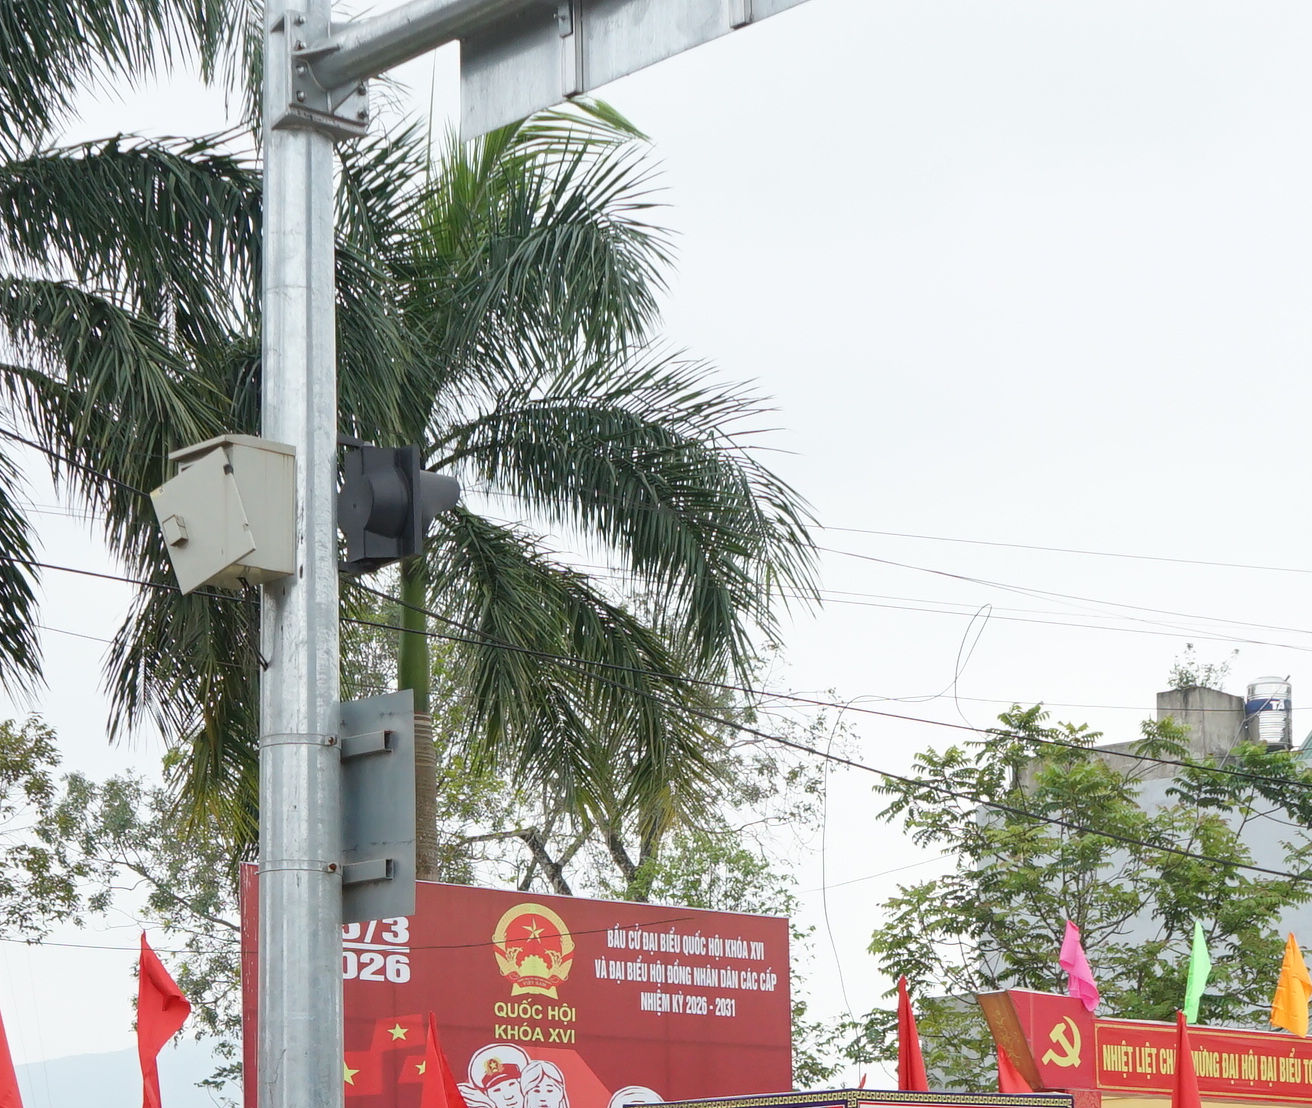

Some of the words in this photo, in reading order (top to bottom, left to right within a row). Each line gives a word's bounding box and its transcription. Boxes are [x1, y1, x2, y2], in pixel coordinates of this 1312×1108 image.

[343, 917, 410, 943] 5/3
[629, 923, 641, 949] CỬ
[643, 932, 658, 955] ĐẠI
[660, 927, 680, 953] BIỂU
[683, 930, 706, 956] QUỐC
[709, 934, 722, 960] HỘI
[725, 936, 748, 959] KHÓA
[750, 942, 764, 960] XVI
[343, 952, 410, 983] 026
[595, 956, 607, 979] VÀ
[609, 961, 624, 984] ĐẠI
[627, 955, 647, 982] BIỂU
[650, 960, 665, 987] HỘI
[694, 964, 718, 987] NHÂN
[720, 966, 738, 988] DÂN
[741, 968, 757, 990] CÁC
[760, 967, 777, 991] CẤP
[494, 999, 543, 1019] QUỐC
[548, 1004, 575, 1022] HỘI
[641, 989, 670, 1015] NHIỆM
[673, 990, 684, 1013] KỲ
[686, 996, 707, 1015] 2026
[715, 998, 735, 1016] 2031
[495, 1021, 544, 1042] KHÓA
[549, 1029, 575, 1043] XVI
[1103, 1040, 1133, 1078] NHIỆT
[1136, 1042, 1156, 1079] LIỆT
[1222, 1052, 1238, 1084] ĐẠI
[1242, 1049, 1258, 1085] HỘI
[1260, 1056, 1276, 1087] ĐẠI
[1279, 1048, 1301, 1083] BIỂU
